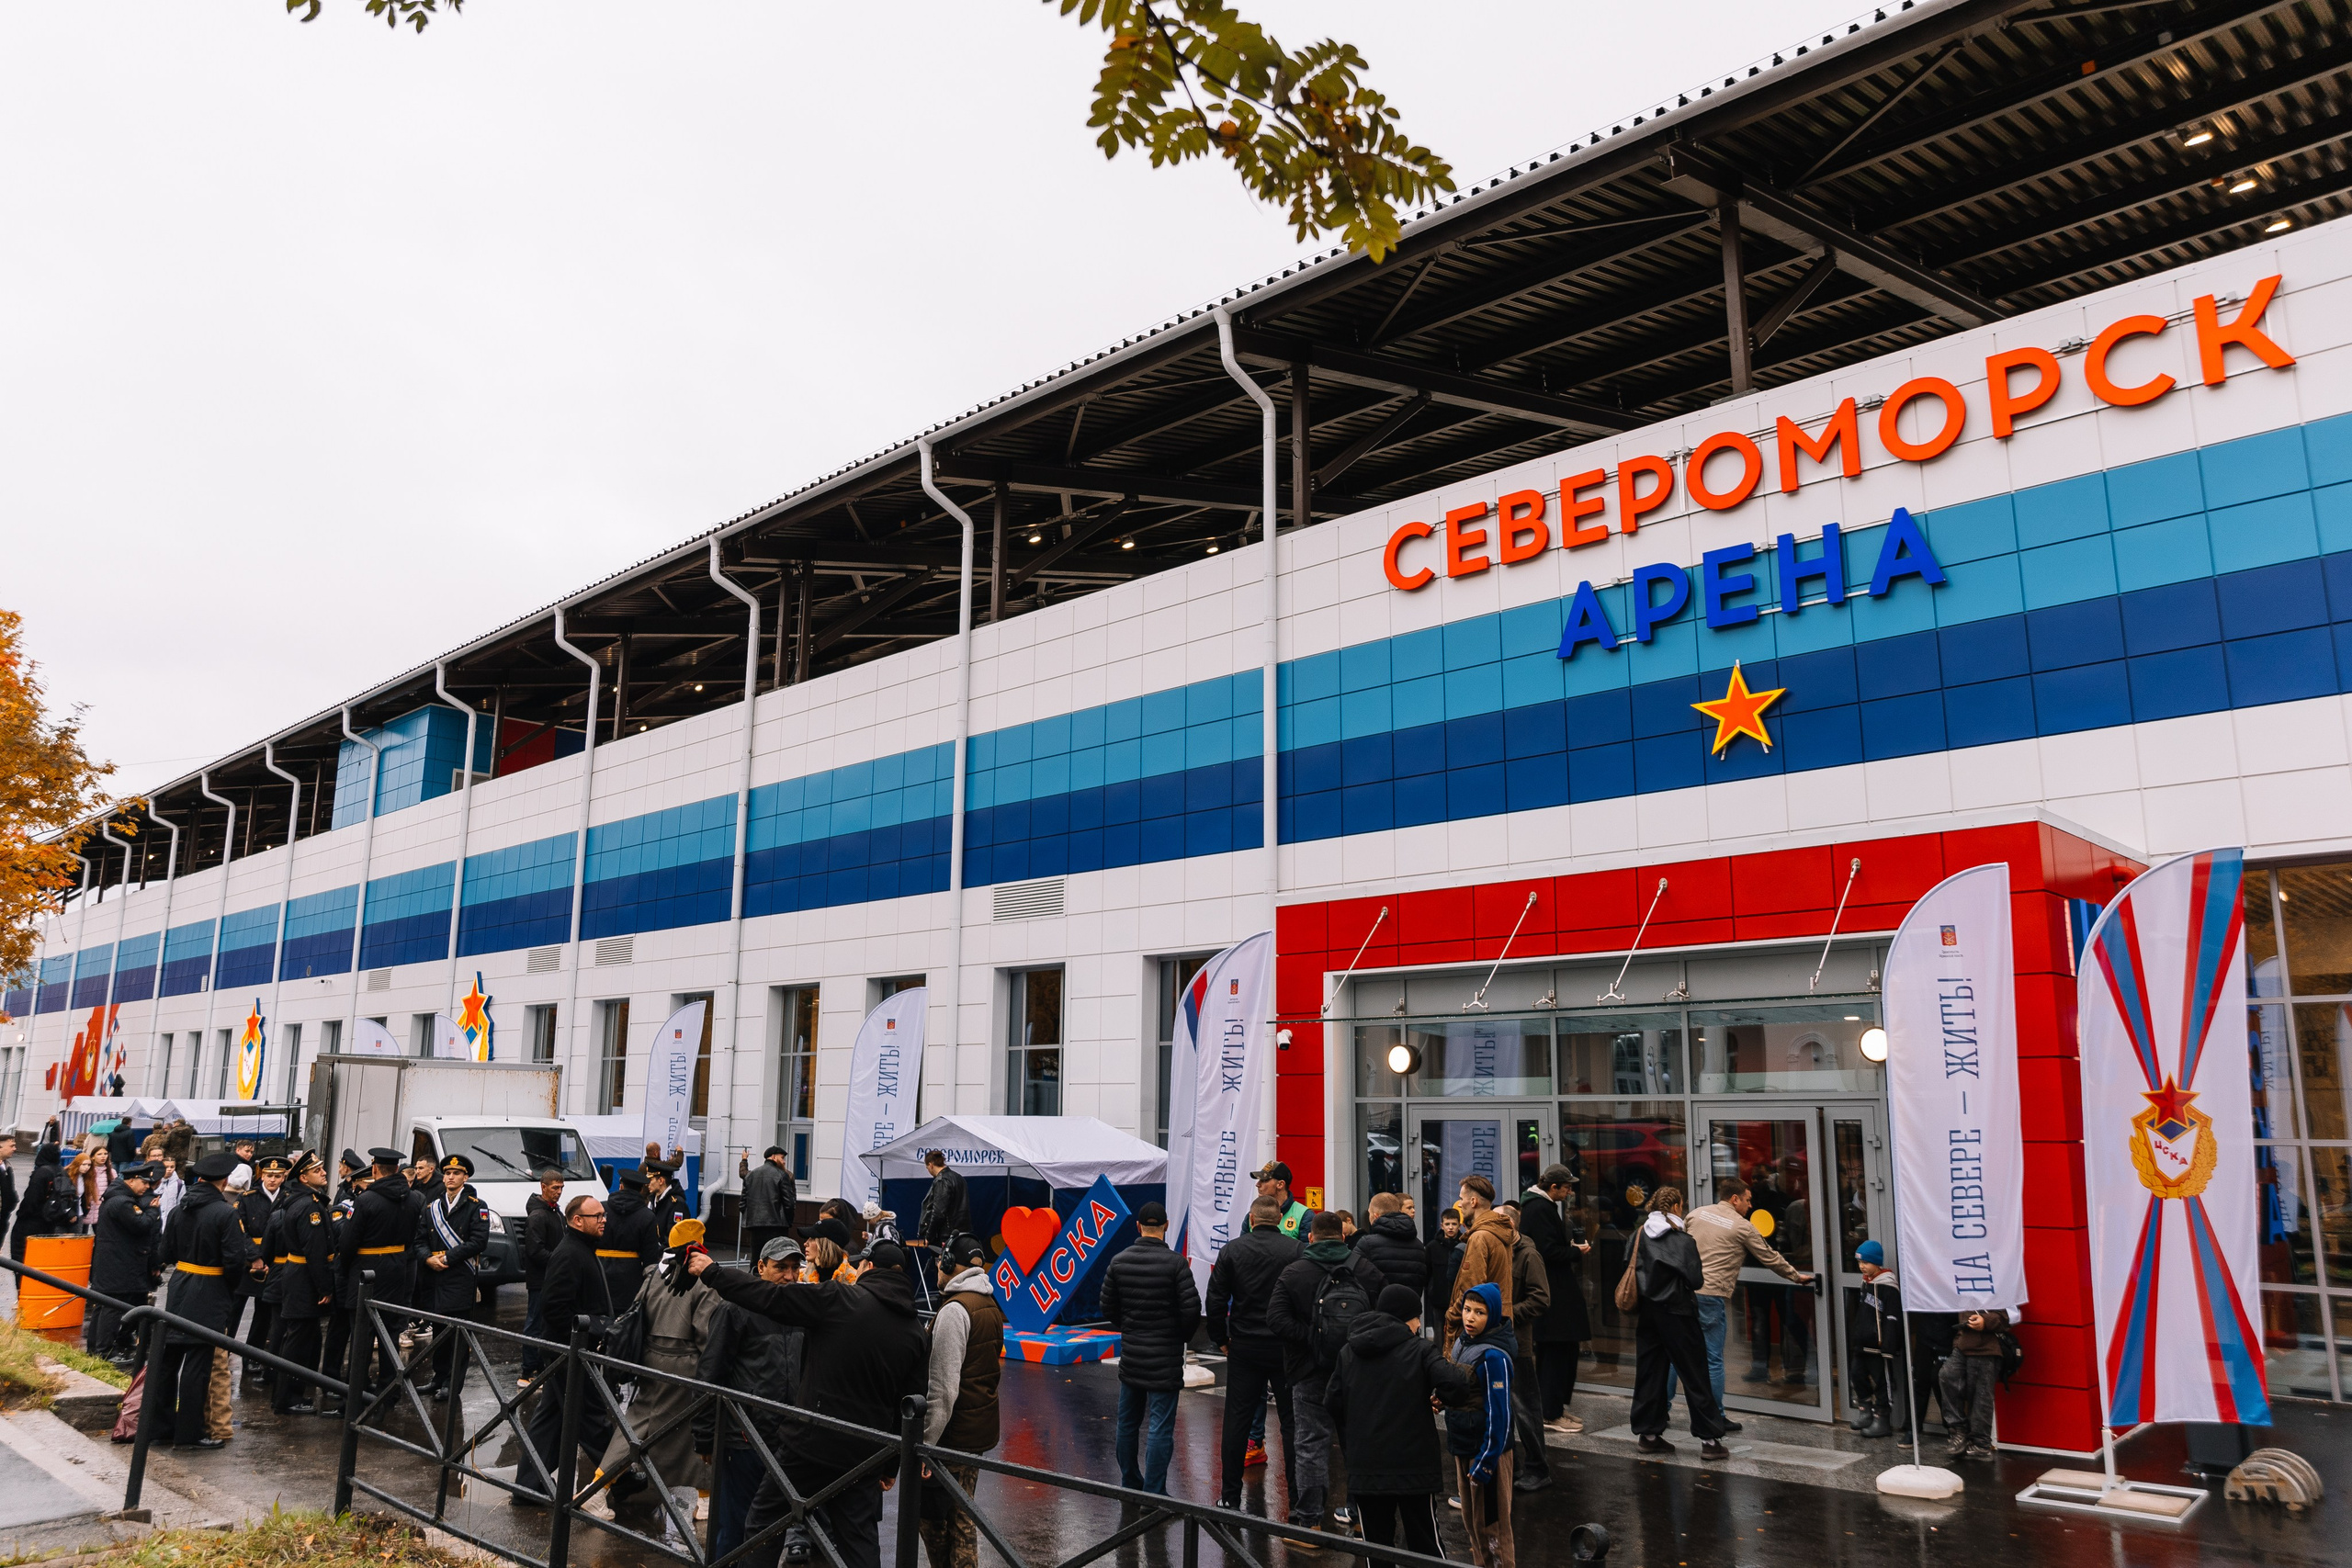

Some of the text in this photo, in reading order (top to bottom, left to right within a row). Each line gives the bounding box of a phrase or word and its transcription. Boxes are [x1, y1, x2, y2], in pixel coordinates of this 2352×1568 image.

[1383, 273, 2297, 591] СЕВЕРОМОРСК
[1555, 507, 1947, 660] АРЕНА
[1222, 1019, 1244, 1093] ЖИТЬ!
[1938, 978, 1979, 1079] ЖИТЬ!
[669, 1052, 687, 1097] ЖИТЬ!
[877, 1045, 900, 1098] ЖИТЬ!
[1215, 1131, 1237, 1213] СЕВЕРЕ
[1949, 1129, 1987, 1239] СЕВЕРЕ
[2154, 1141, 2188, 1165] ЦСКА
[1029, 1200, 1117, 1314] ЦСКА
[1210, 1223, 1229, 1250] НА
[1952, 1252, 1995, 1294] НА
[996, 1258, 1021, 1302] Я
